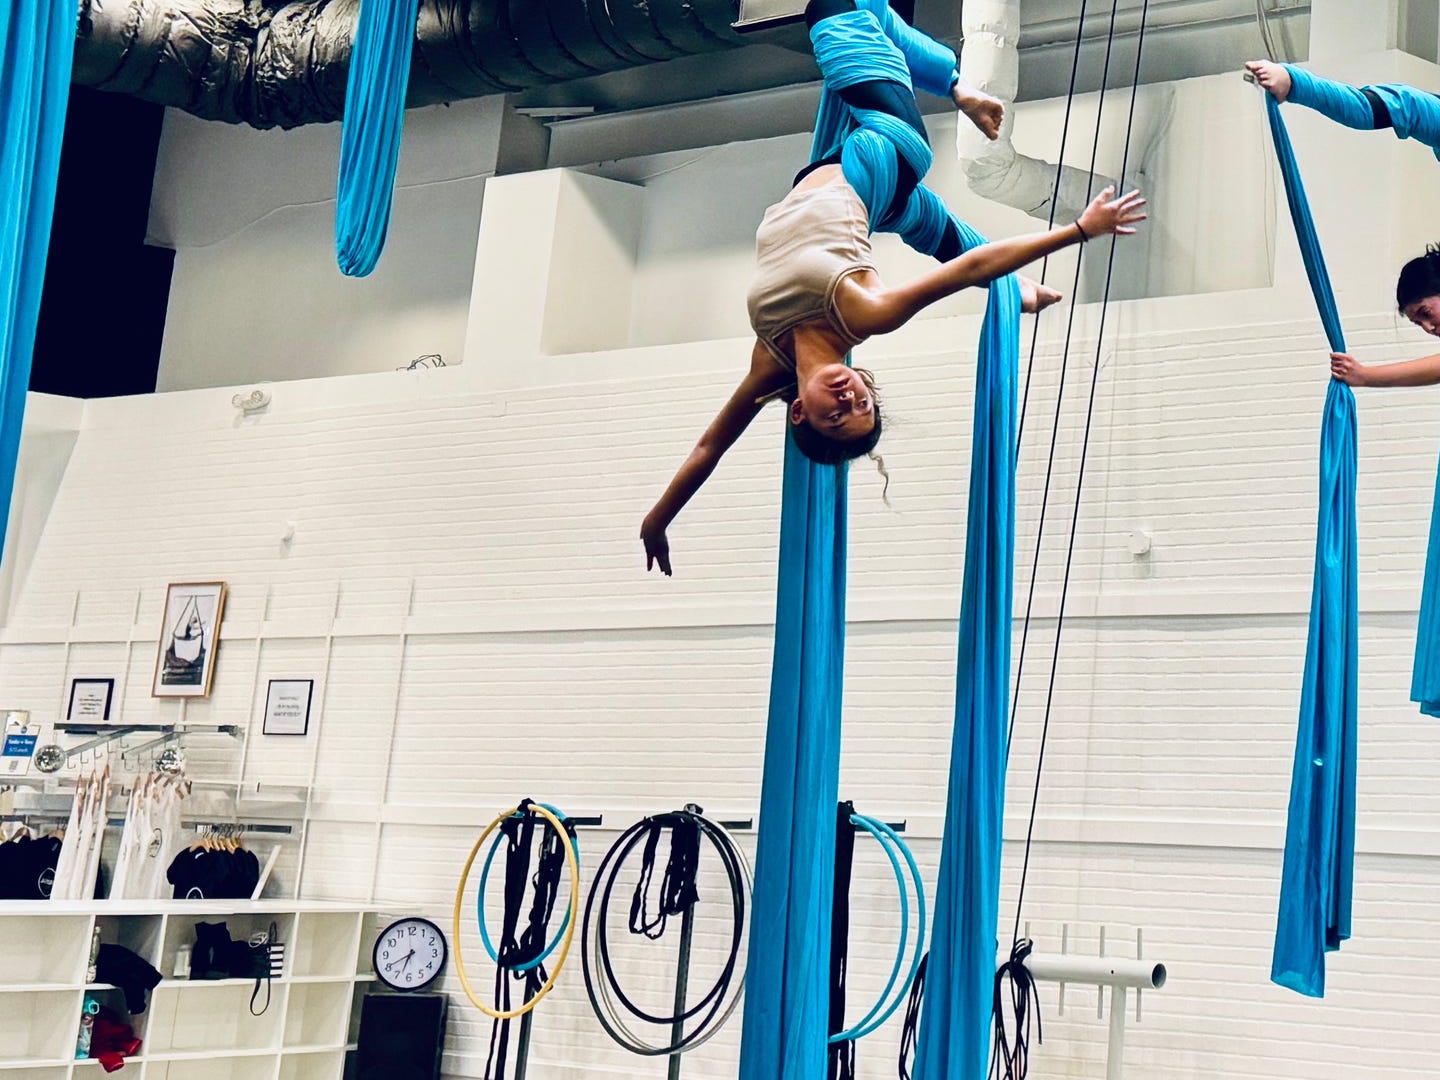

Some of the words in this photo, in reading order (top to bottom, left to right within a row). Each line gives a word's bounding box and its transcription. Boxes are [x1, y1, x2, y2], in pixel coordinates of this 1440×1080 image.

[397, 930, 404, 938] 11
[408, 926, 416, 936] 12
[388, 938, 396, 947] 10
[428, 937, 435, 946] 2
[382, 951, 389, 959] 9
[432, 949, 438, 958] 3
[385, 963, 392, 972] 8
[426, 961, 432, 970] 4
[394, 971, 400, 979] 7
[405, 973, 412, 982] 6
[418, 969, 424, 979] 5
